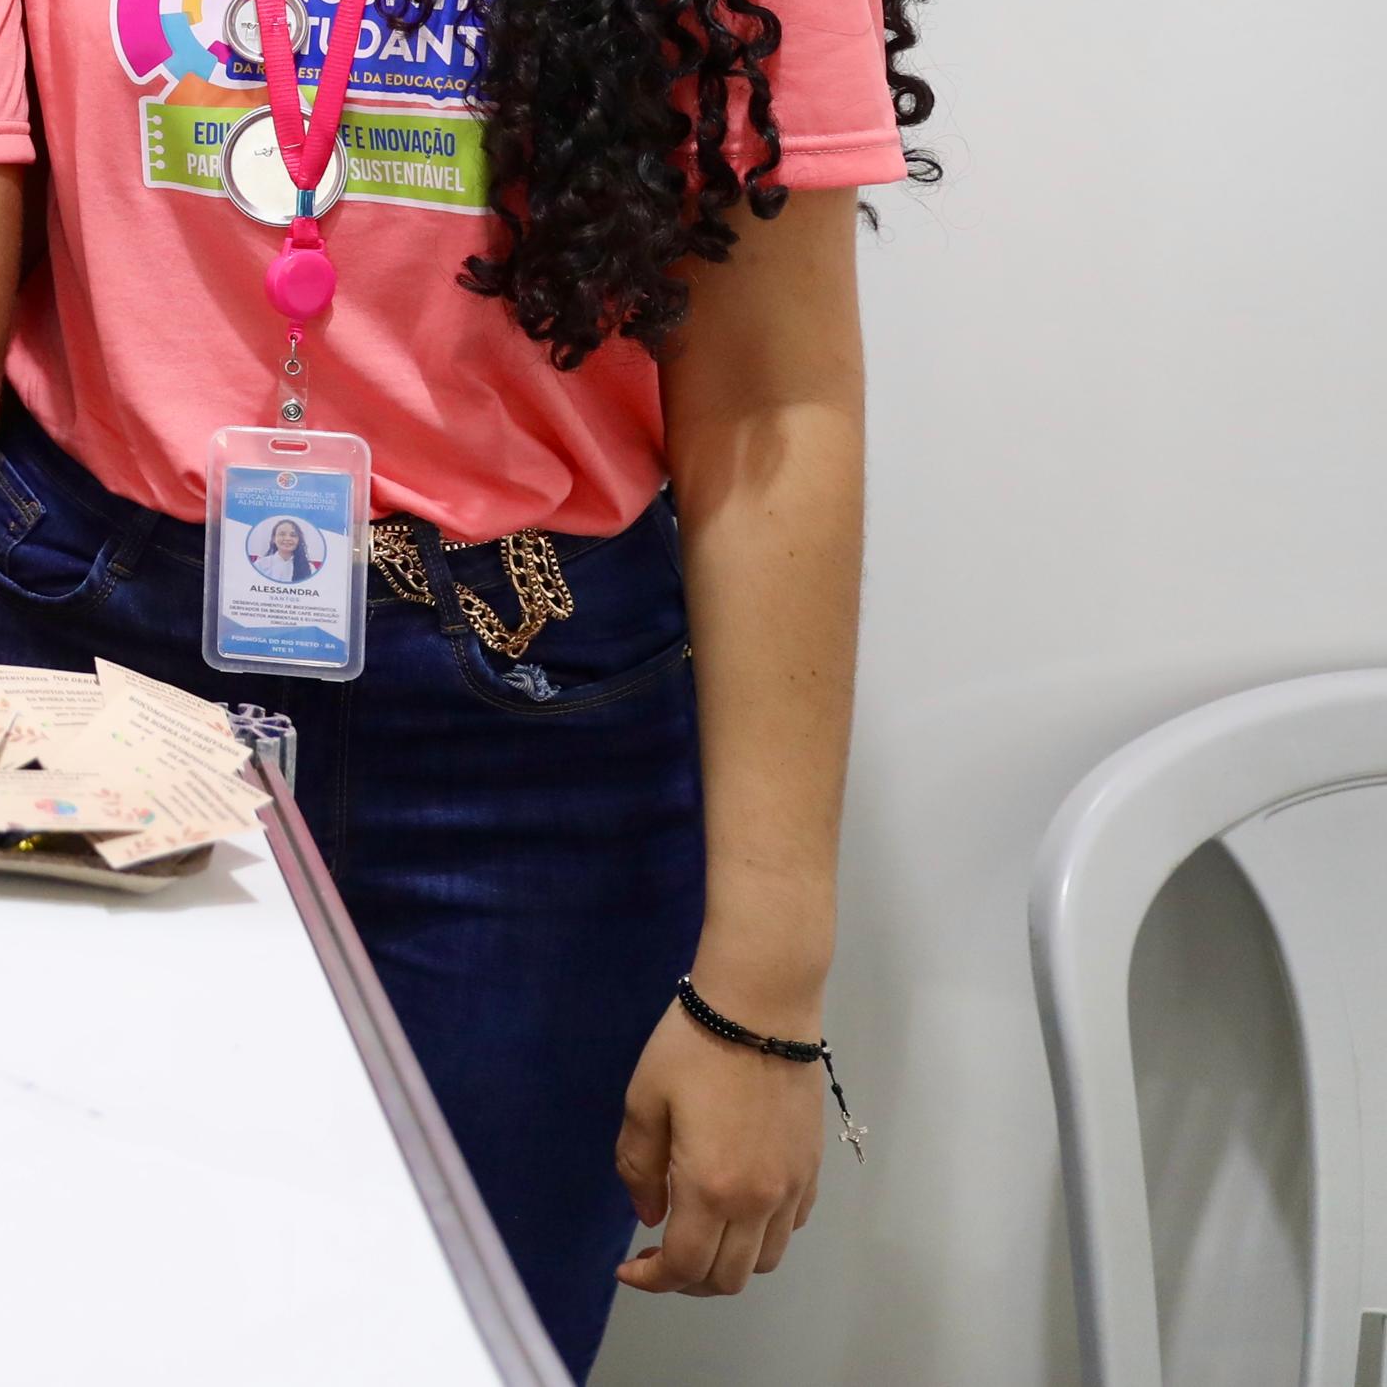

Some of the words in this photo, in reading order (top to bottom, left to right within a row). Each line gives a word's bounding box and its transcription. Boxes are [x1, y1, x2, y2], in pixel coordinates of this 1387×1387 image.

[234, 63, 253, 75] DA
[298, 68, 361, 84] ESTAL
[363, 73, 382, 84] DA
[385, 74, 466, 93] EDUCAÇÃO
[370, 126, 455, 159] INOVAÇÃO
[187, 153, 219, 177] PAR
[350, 154, 464, 192] SUSTENTÁVEL
[250, 585, 319, 597] ALESSANDRA
[231, 635, 267, 644] FORMOSA
